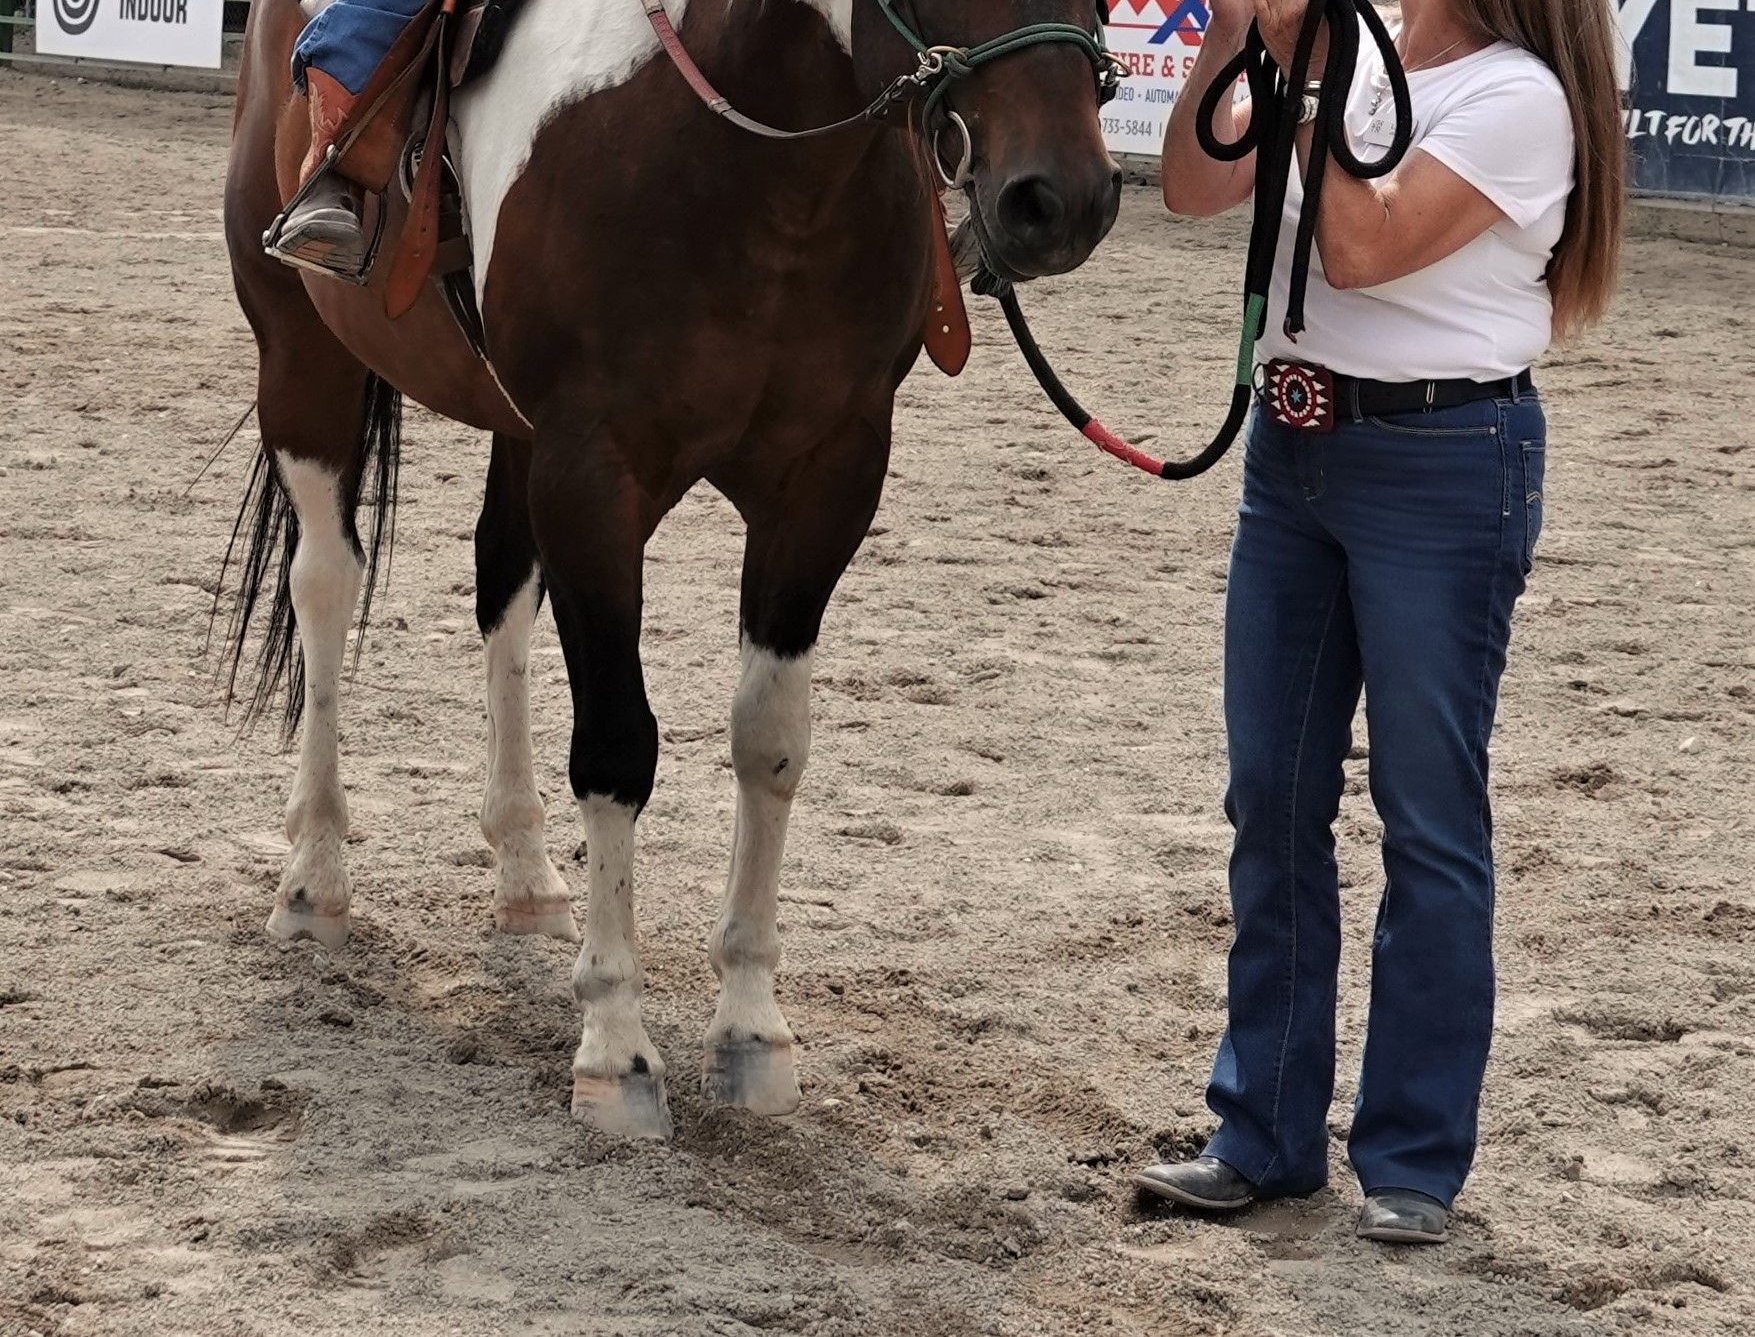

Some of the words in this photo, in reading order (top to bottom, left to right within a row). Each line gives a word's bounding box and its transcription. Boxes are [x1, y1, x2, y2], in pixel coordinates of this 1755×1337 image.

[1161, 55, 1175, 78] &
[1145, 88, 1179, 104] AUTOM
[1664, 113, 1721, 146] FOR
[1722, 116, 1755, 151] TH
